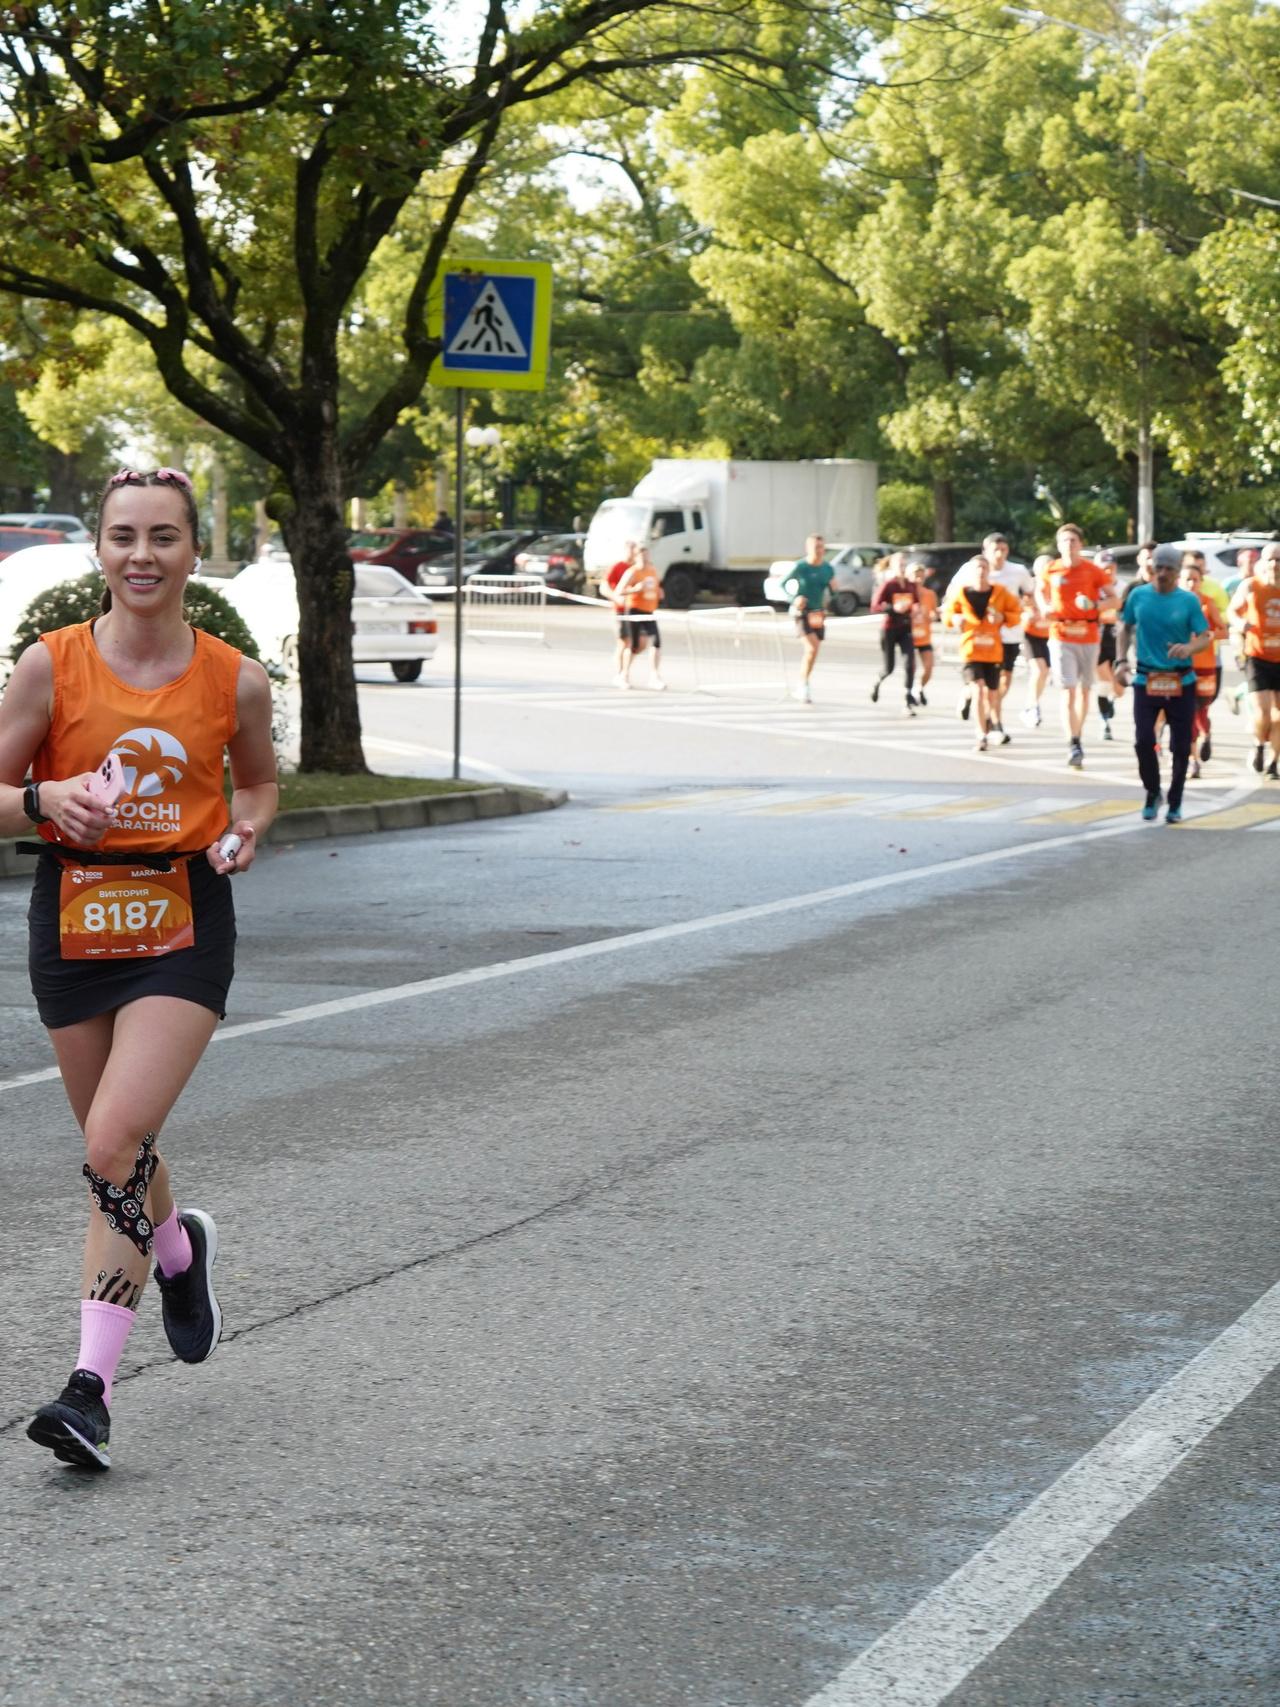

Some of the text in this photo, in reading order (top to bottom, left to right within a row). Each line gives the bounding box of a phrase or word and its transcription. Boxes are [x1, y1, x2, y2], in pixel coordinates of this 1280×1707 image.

[110, 820, 180, 832] ARATHON
[131, 867, 177, 877] MARATN
[99, 889, 149, 898] ВИКТОРИЯ
[84, 899, 169, 932] 8187
